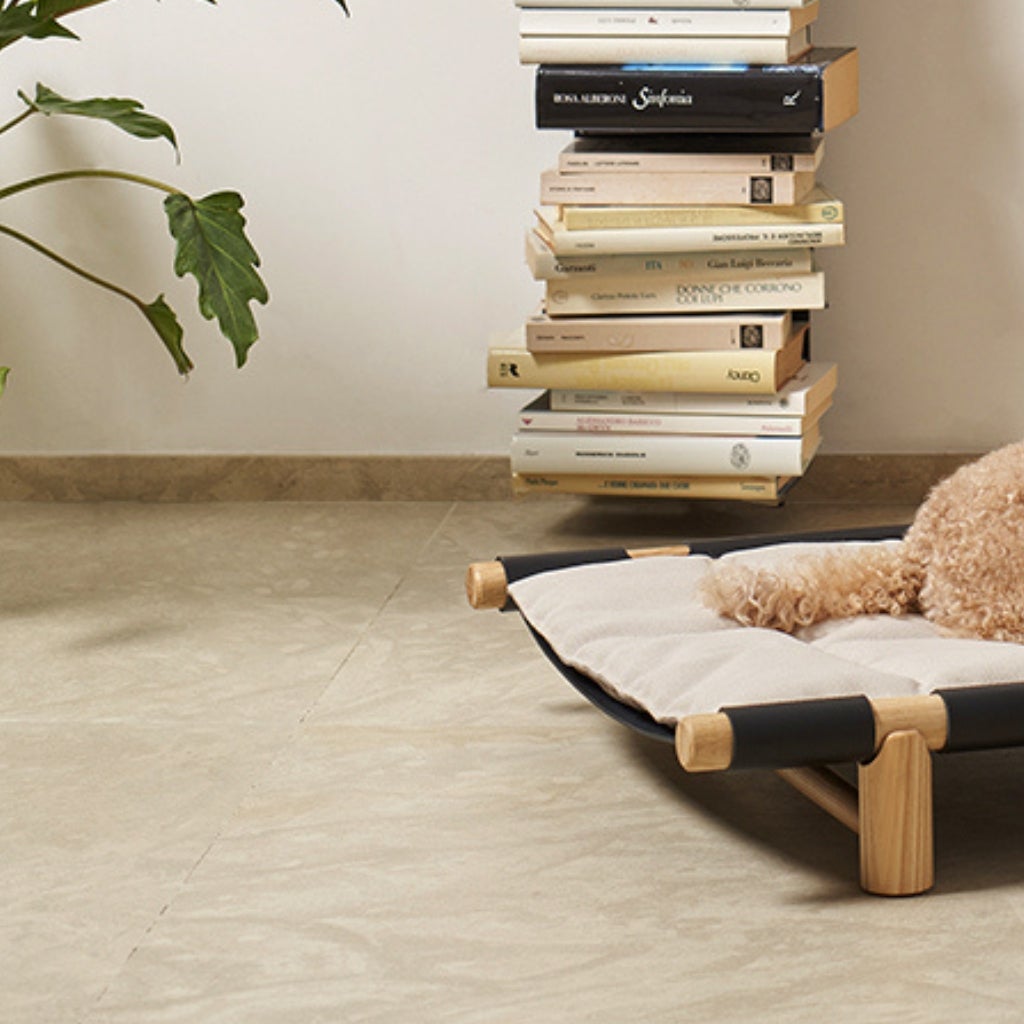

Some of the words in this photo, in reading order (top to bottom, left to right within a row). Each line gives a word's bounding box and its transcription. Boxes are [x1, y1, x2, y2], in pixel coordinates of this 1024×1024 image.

[631, 85, 693, 111] Sinfonia
[707, 259, 728, 269] Gian
[730, 258, 753, 271] Luigi
[676, 283, 715, 295] DONNE
[718, 283, 741, 294] CHE
[744, 282, 803, 294] CORRONO
[728, 369, 761, 383] Clancy
